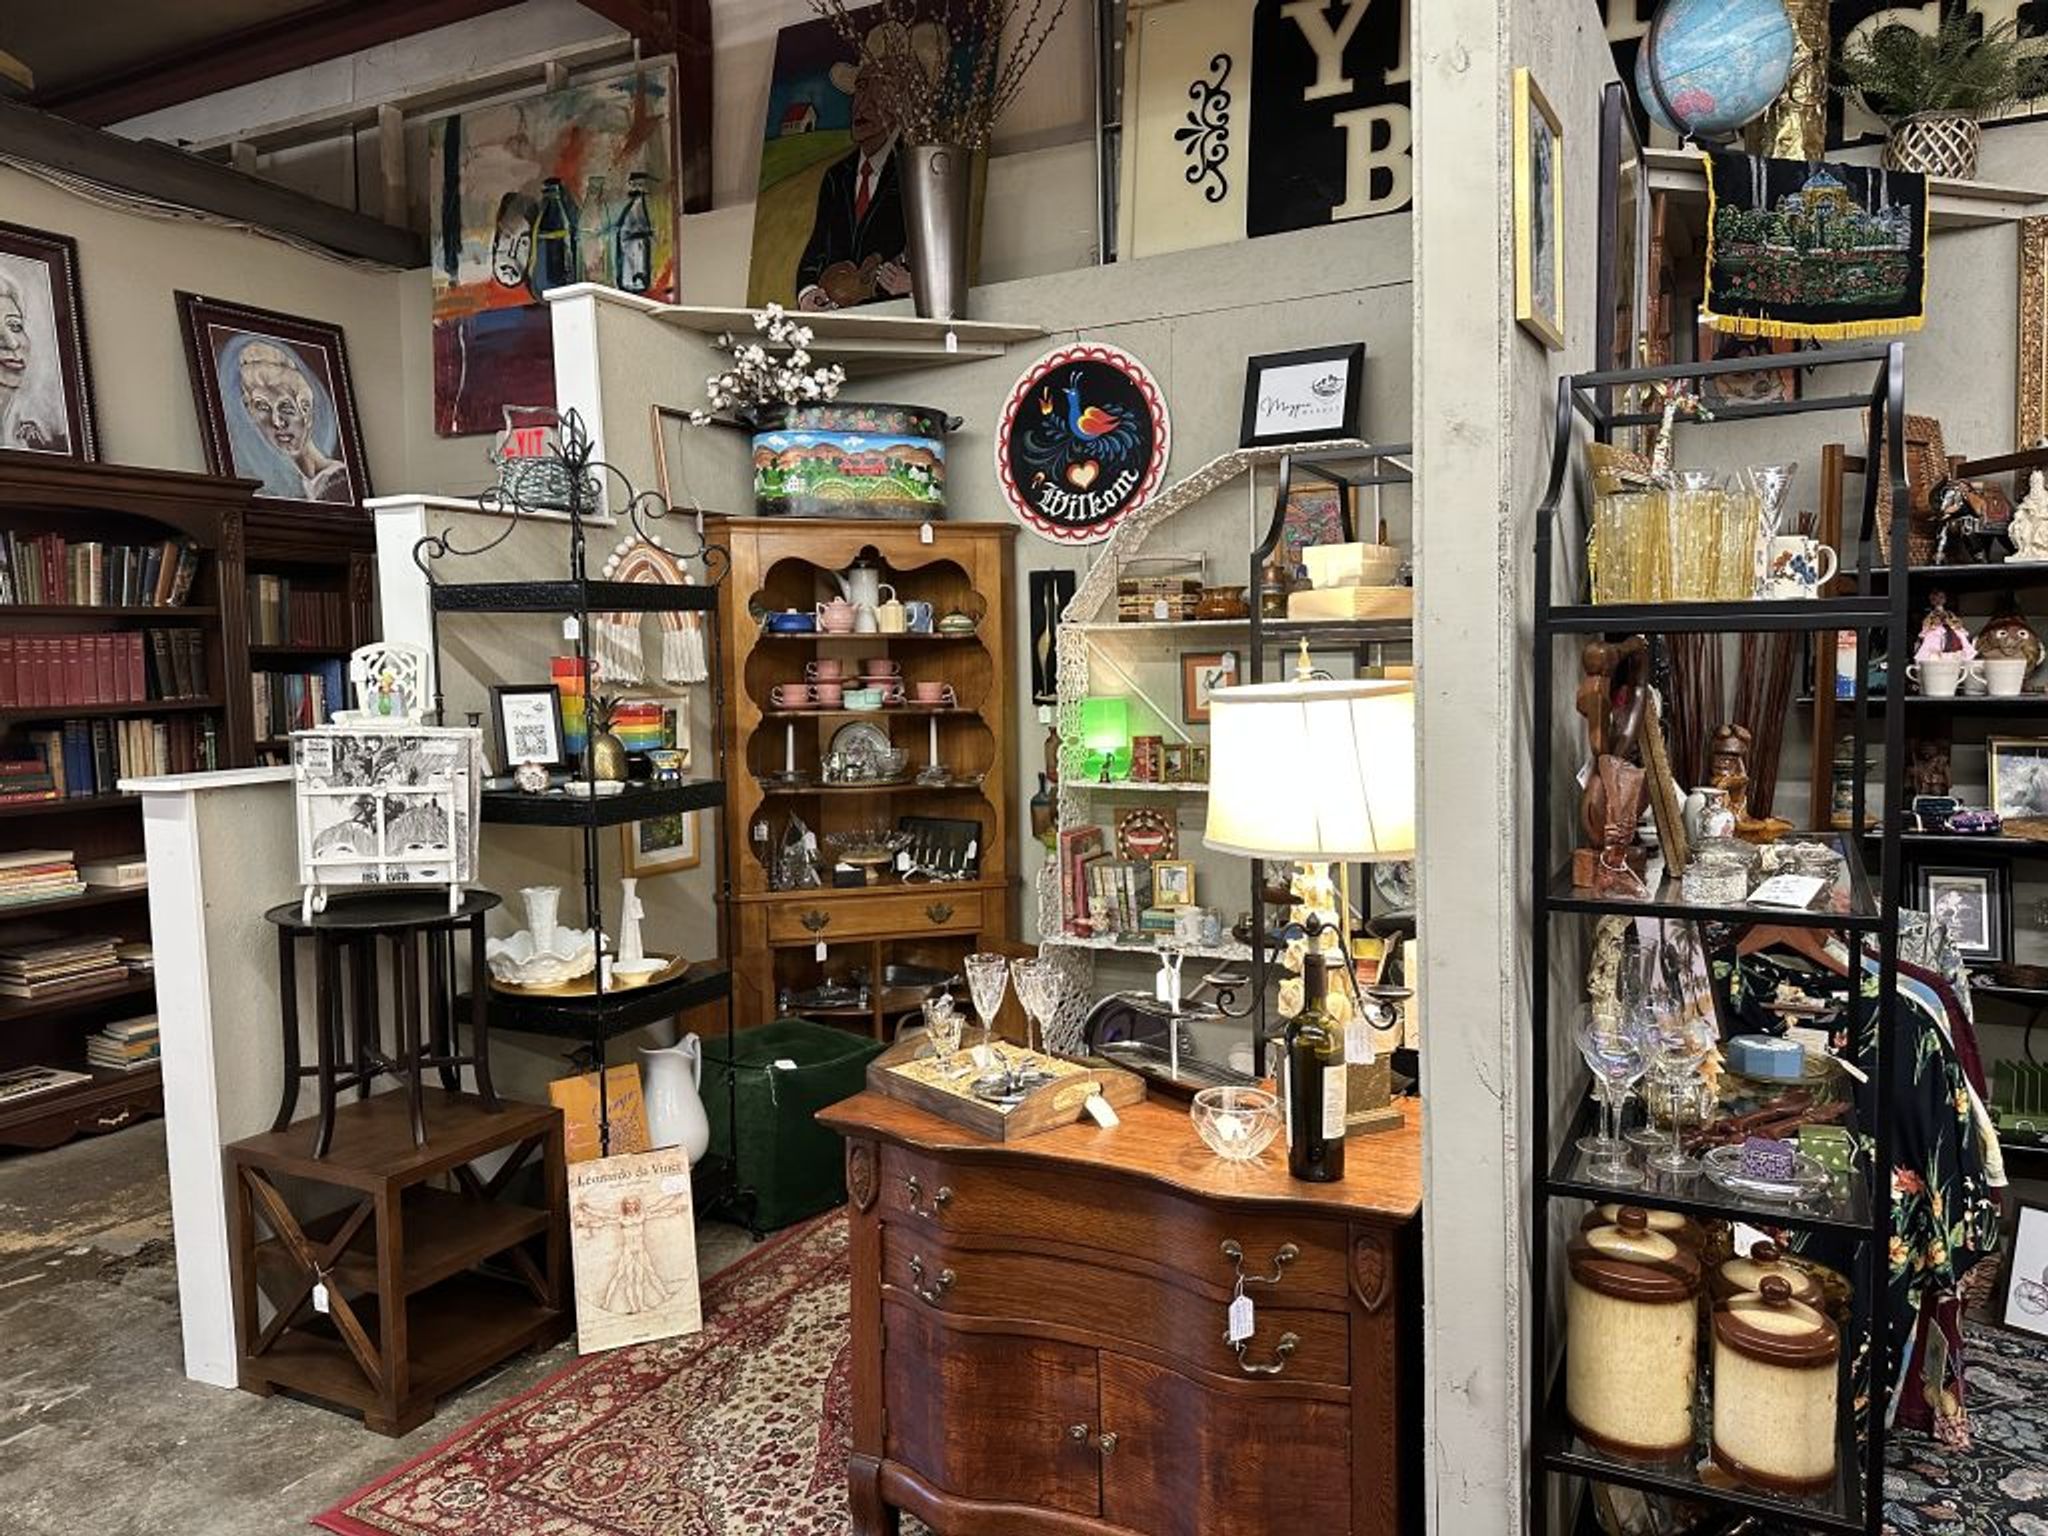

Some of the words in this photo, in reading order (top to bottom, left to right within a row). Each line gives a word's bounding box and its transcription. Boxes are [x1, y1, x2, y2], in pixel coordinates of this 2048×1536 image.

[504, 428, 545, 458] XIT
[577, 1168, 632, 1187] Leonardo
[636, 1165, 649, 1178] da
